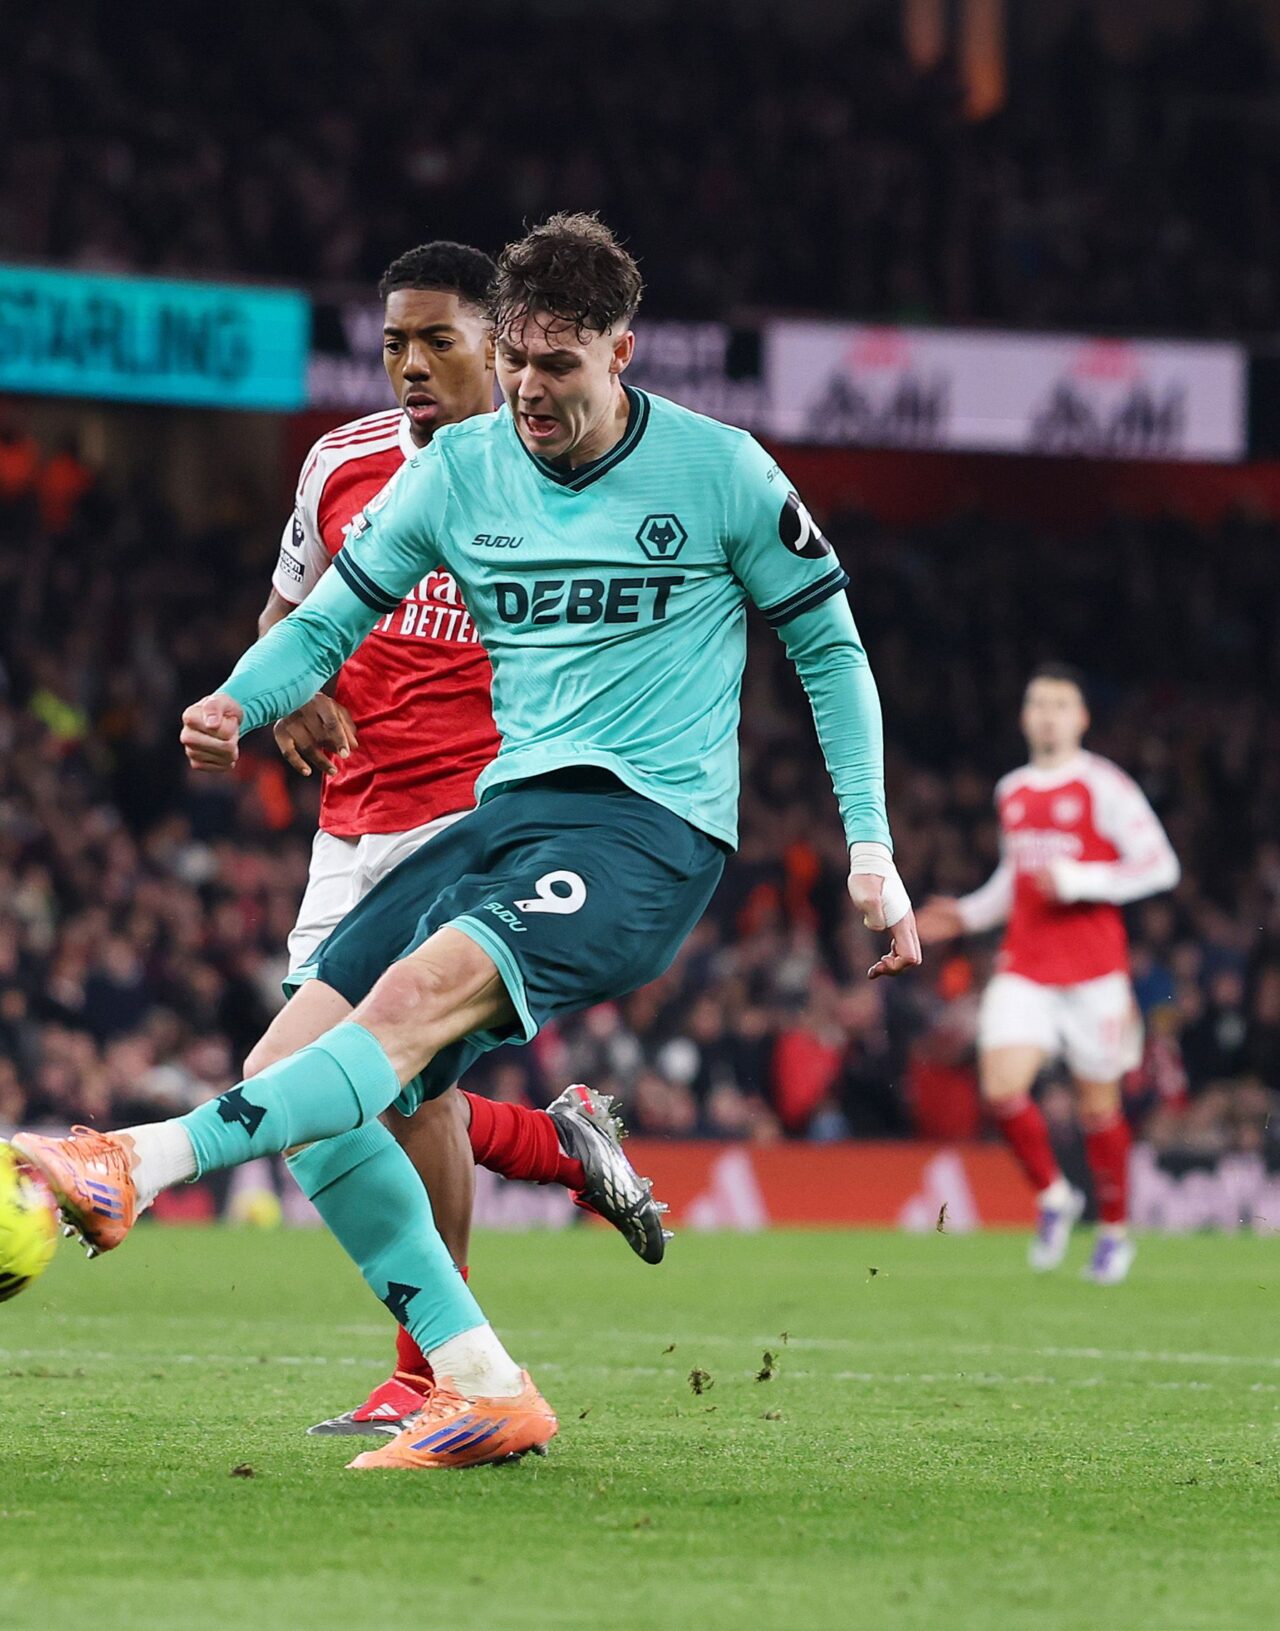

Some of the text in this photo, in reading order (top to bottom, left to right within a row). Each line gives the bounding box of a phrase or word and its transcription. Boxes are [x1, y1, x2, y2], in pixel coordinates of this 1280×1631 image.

[472, 533, 524, 549] SUDU
[494, 575, 686, 625] DEBET
[400, 603, 479, 643] BETTE
[513, 870, 587, 915] 9
[483, 901, 528, 932] SUDU
